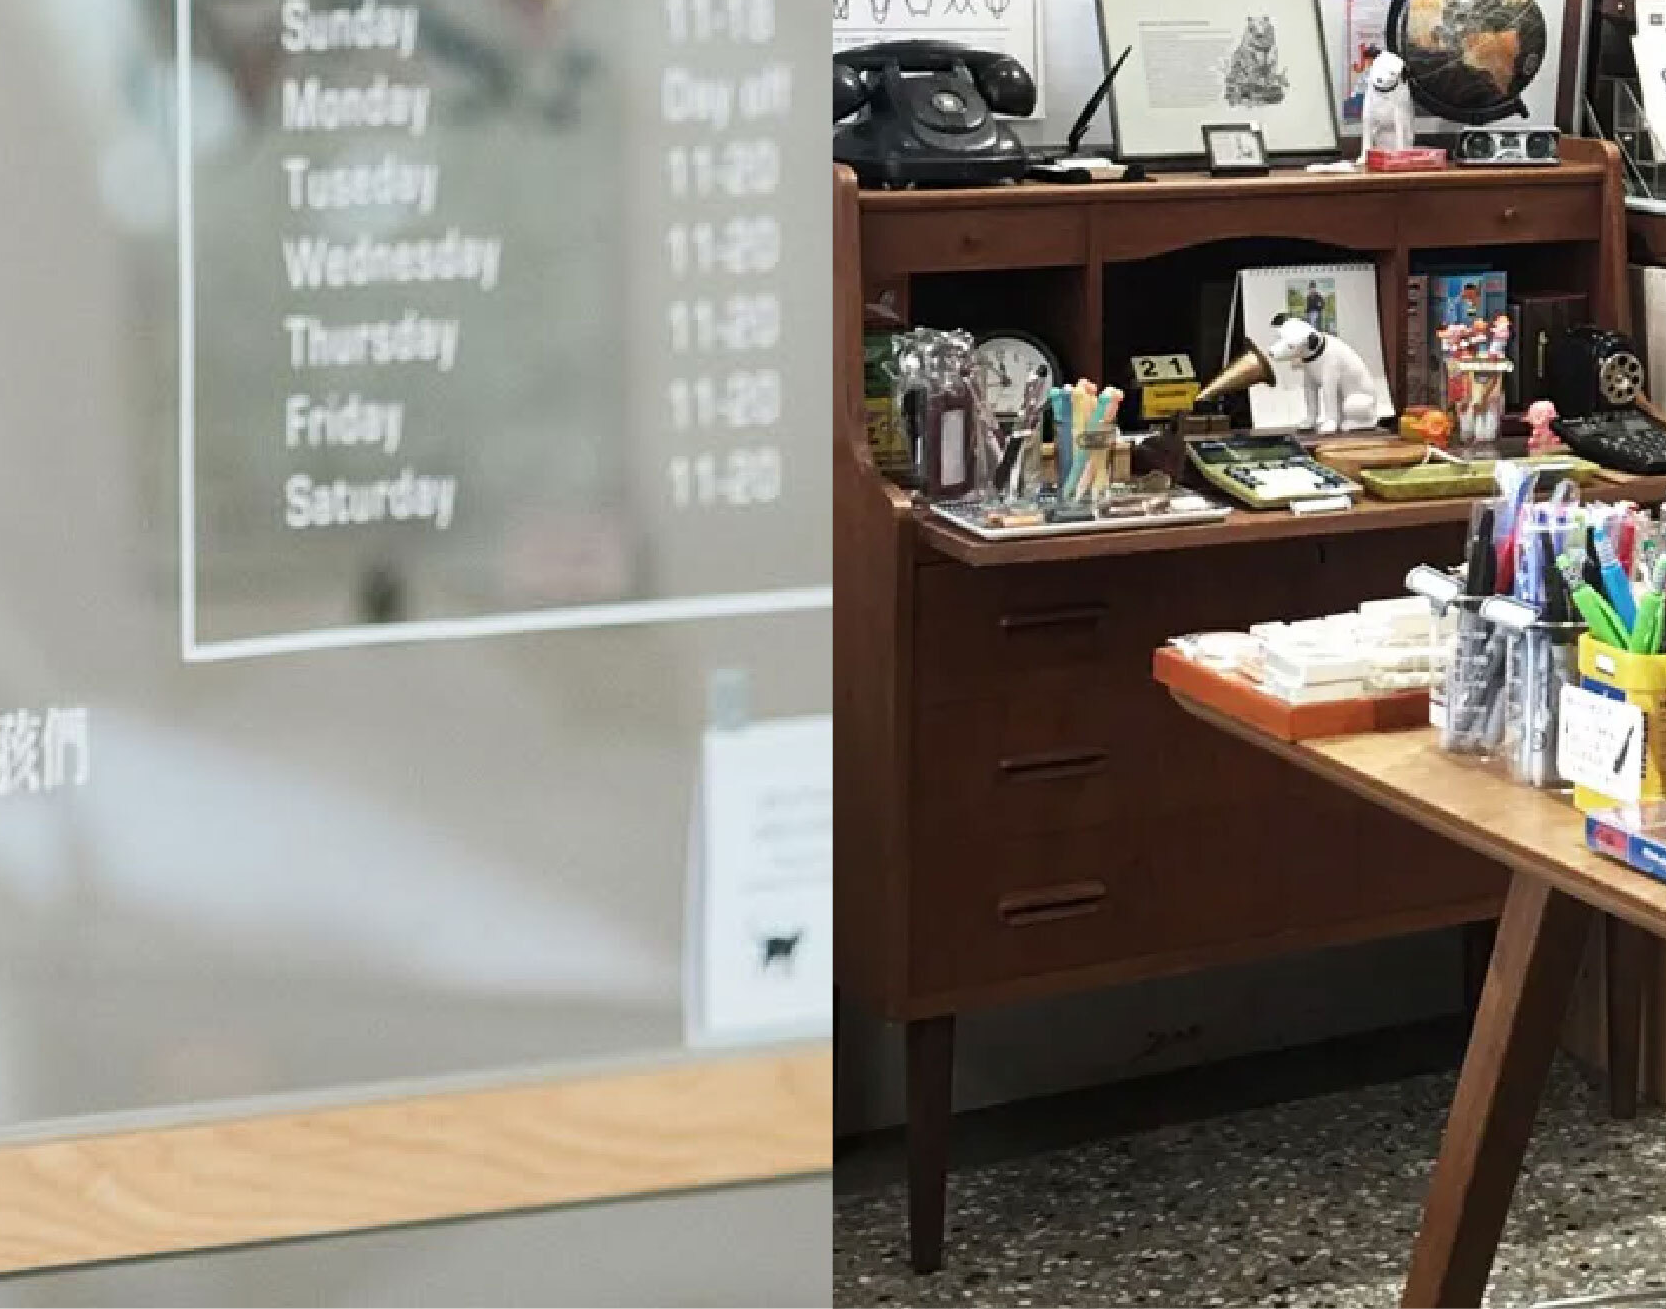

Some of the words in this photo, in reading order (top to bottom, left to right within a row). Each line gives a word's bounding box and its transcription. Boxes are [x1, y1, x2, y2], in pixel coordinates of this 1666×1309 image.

[282, 74, 432, 136] Monday
[661, 64, 732, 132] Day
[664, 139, 781, 195] 11-20
[282, 226, 503, 291] Wednesday
[665, 215, 781, 274] 11-20
[284, 308, 460, 372] Thursday
[666, 294, 781, 352] 11-20
[286, 392, 404, 455] Friday
[667, 368, 781, 429] 11-20
[284, 468, 457, 529] Saturday
[668, 446, 782, 507] 11-20
